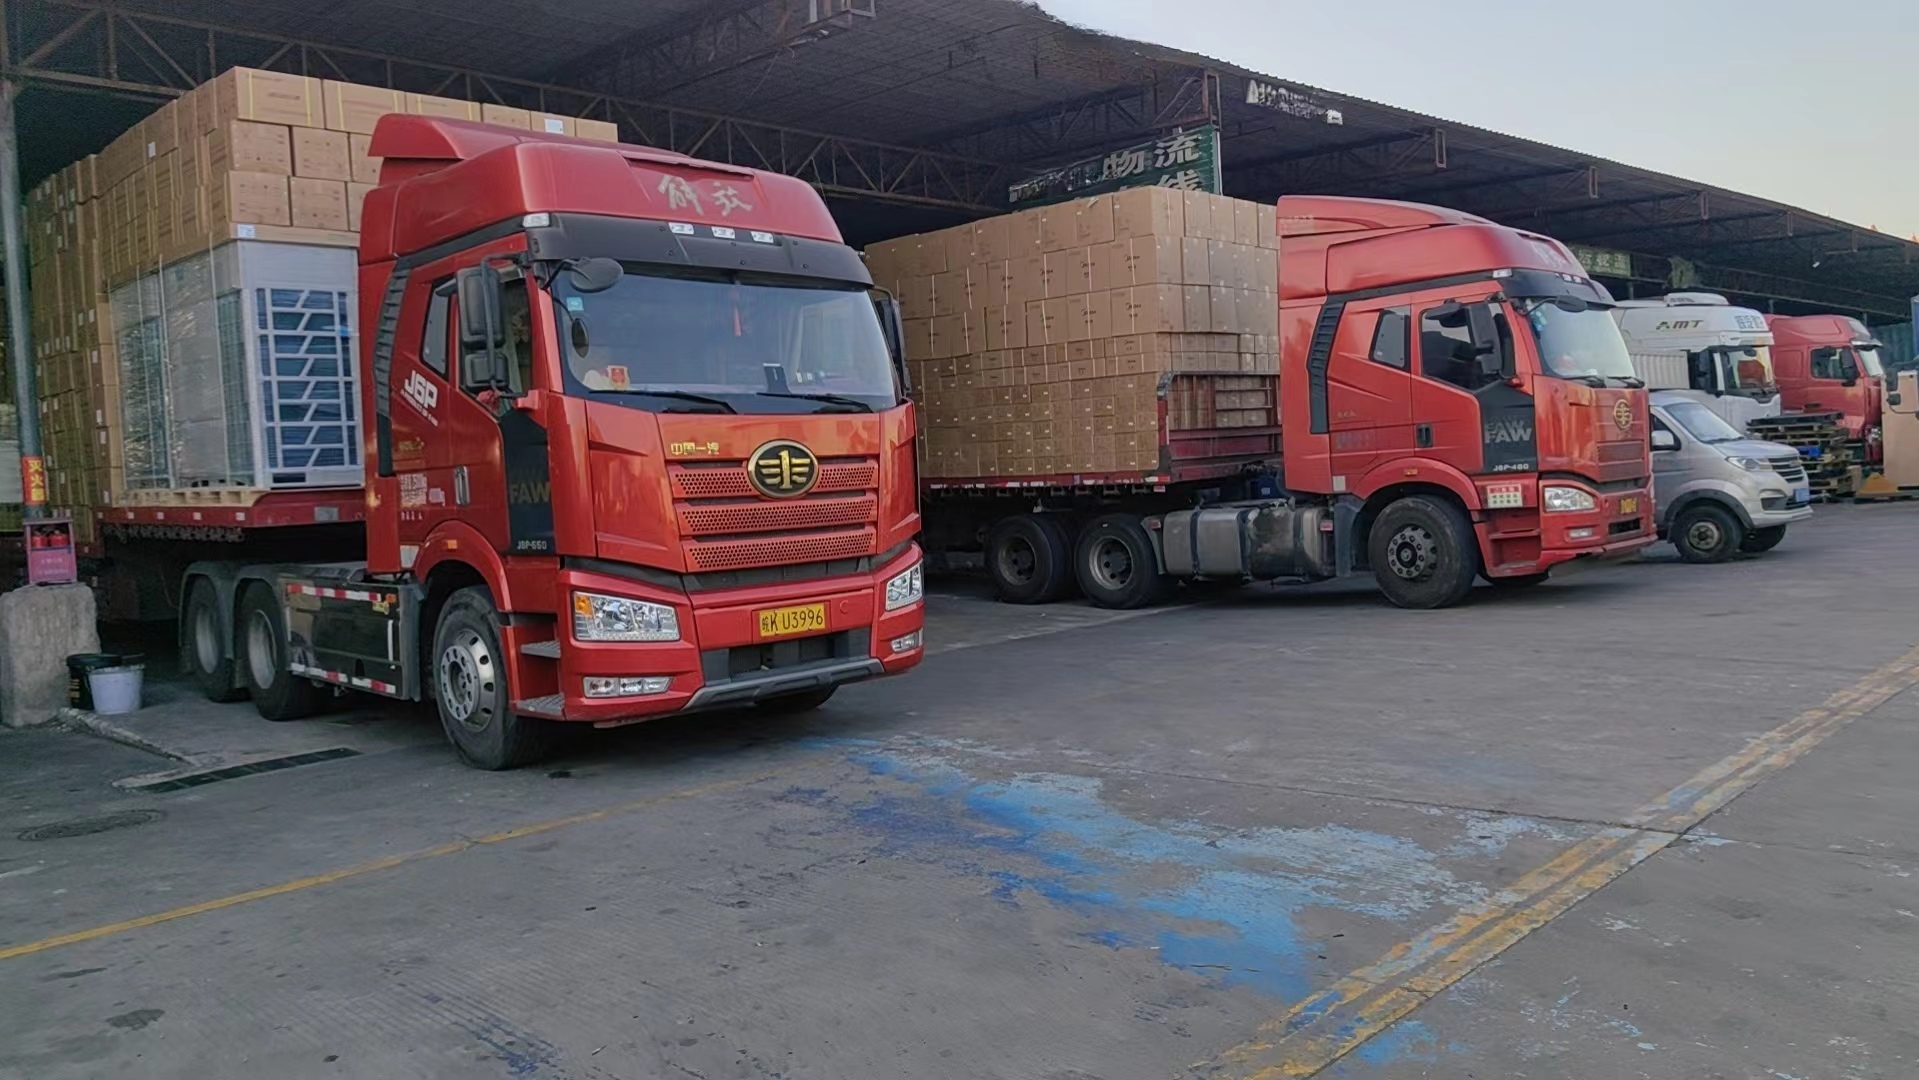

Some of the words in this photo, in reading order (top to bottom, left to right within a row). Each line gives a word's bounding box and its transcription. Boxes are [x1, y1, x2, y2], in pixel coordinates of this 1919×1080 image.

[1656, 320, 1703, 329] AMT
[403, 369, 438, 409] J6P
[1484, 428, 1532, 444] FAW
[670, 442, 719, 455] 中国一汽
[509, 482, 550, 504] FAW
